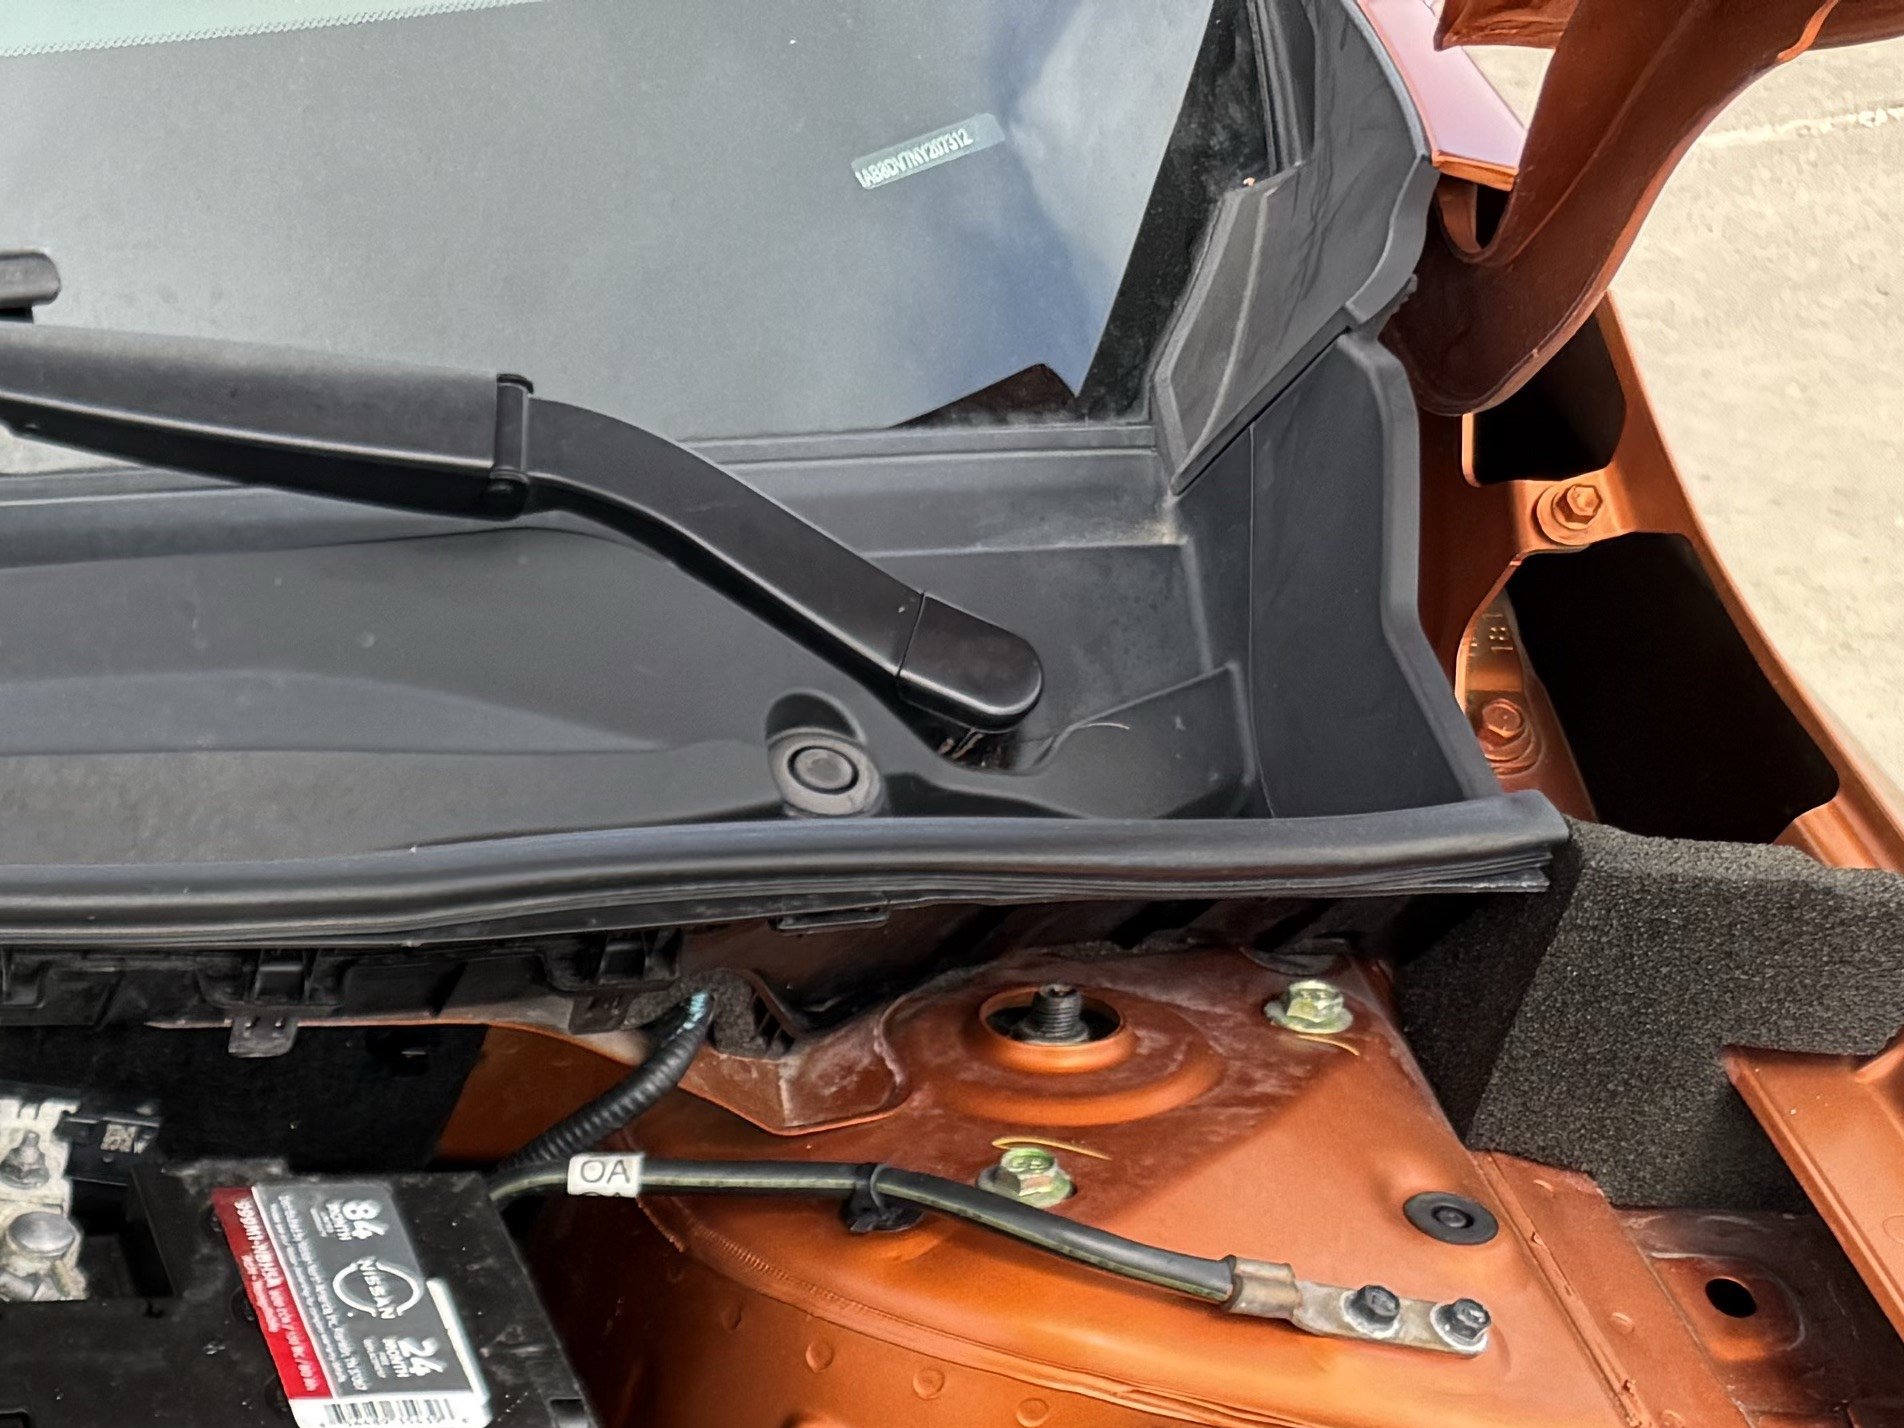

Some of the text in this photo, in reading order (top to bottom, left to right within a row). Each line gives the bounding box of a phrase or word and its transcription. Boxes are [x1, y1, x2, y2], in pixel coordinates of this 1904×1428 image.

[342, 1199, 389, 1240] 84
[357, 1255, 397, 1320] NISSAN
[397, 1336, 447, 1377] 24
